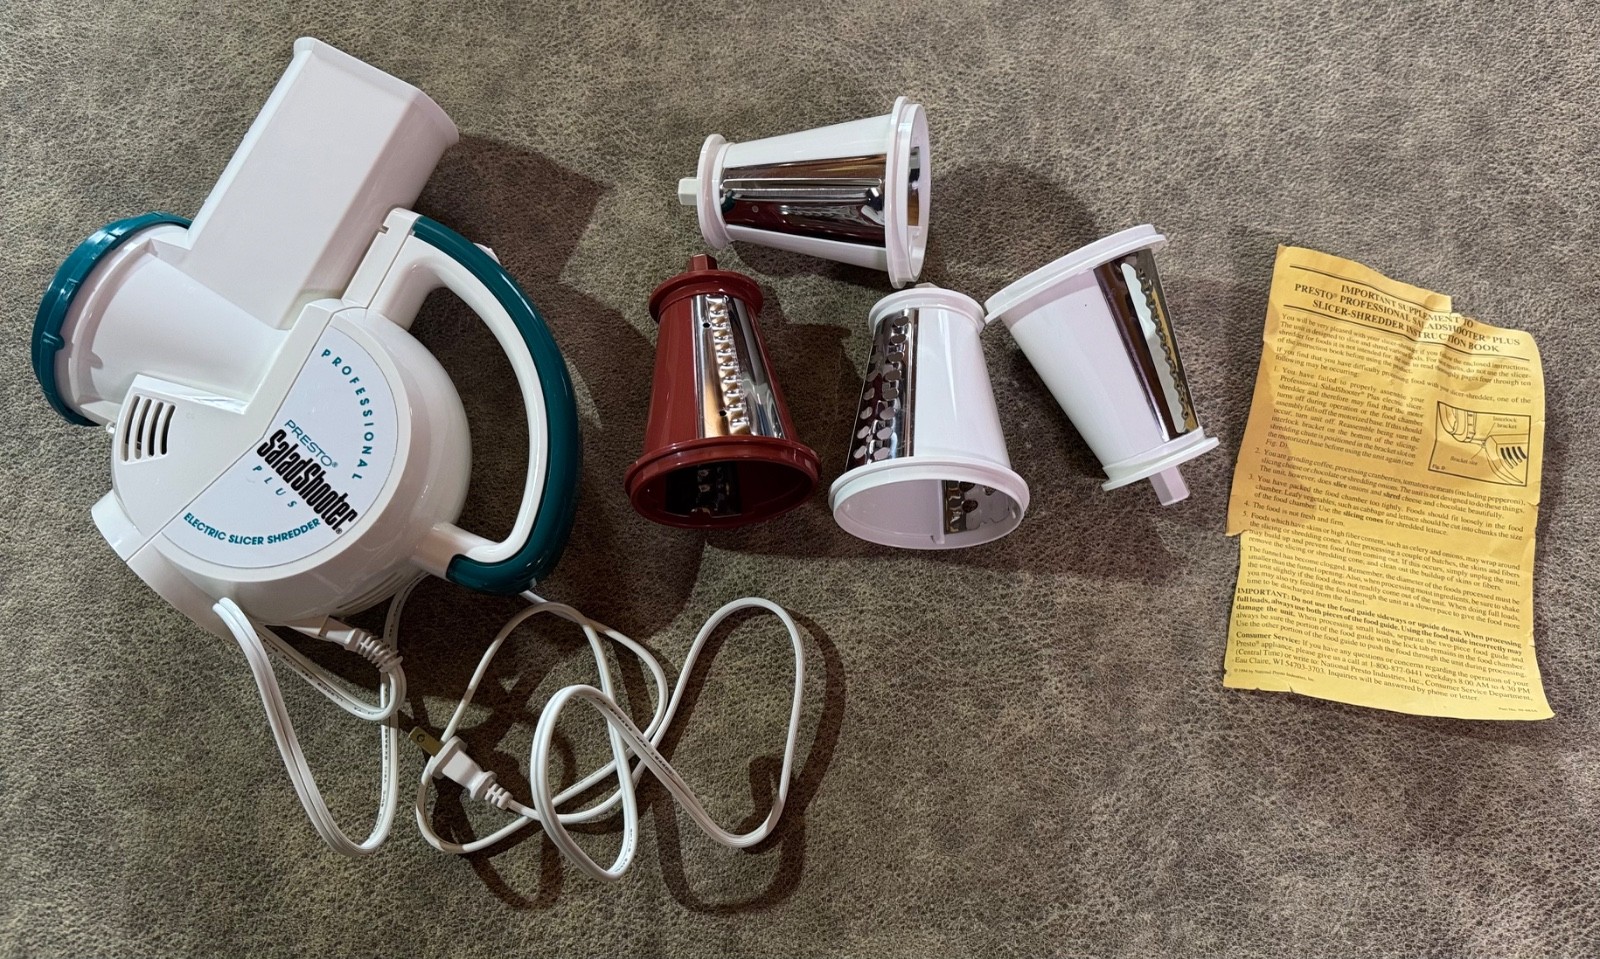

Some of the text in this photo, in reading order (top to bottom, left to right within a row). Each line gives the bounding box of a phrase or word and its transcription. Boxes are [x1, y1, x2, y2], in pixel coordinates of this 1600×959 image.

[1312, 300, 1500, 352] SLICER-SHREDDER INSTRUCTION BOOK
[1340, 296, 1411, 321] PROFESSIONAL
[1493, 336, 1521, 345] PLUS
[1341, 285, 1474, 328] IMPORTANT SUPPLEMENT TO
[1282, 367, 1296, 375] You
[1299, 371, 1314, 379] have
[1318, 374, 1337, 383] failed
[1349, 382, 1376, 393] properly
[321, 349, 374, 479] PROFESSIONAL
[1306, 397, 1327, 408] during
[1329, 403, 1358, 414] operation
[1382, 412, 1396, 420] food
[1398, 416, 1423, 426] chamber
[253, 465, 297, 508] PLUS
[1257, 475, 1271, 484] You
[1272, 479, 1287, 487] have
[1289, 482, 1311, 493] packed
[1325, 490, 1339, 498] food
[1341, 494, 1368, 504] chamber
[1406, 507, 1425, 515] Foods
[1427, 511, 1449, 520] should
[1460, 516, 1484, 527] loosely
[1494, 522, 1505, 530] the
[1508, 524, 1524, 533] food
[1260, 465, 1271, 473] The
[1288, 471, 1316, 483] however,
[1317, 477, 1332, 485] does
[1383, 491, 1401, 500] shred
[1401, 495, 1422, 504] cheese
[1423, 499, 1435, 507] and
[1436, 502, 1467, 513] chocolate
[183, 512, 320, 545] ELECTRIC SLICER SHREDDER
[1253, 502, 1265, 510] The
[1266, 505, 1281, 513] food
[1300, 512, 1316, 521] fresh
[1273, 495, 1288, 503] food
[1318, 505, 1331, 513] Use
[1343, 511, 1364, 521] slicing
[1365, 516, 1383, 524] cones
[1396, 521, 1424, 532] shredded
[1236, 603, 1264, 612] damage
[1266, 605, 1277, 613] the
[1280, 609, 1296, 617] unit.
[1297, 612, 1317, 622] When
[1319, 618, 1354, 630] processing
[1355, 624, 1374, 633] small
[1396, 633, 1424, 644] separate
[1473, 648, 1488, 656] food
[1490, 652, 1509, 661] guide
[1237, 587, 1290, 600] IMPORTANT:
[1339, 605, 1355, 613] food
[1356, 608, 1375, 618] guide
[1376, 612, 1407, 625] sideways
[1417, 621, 1439, 631] upside
[1441, 626, 1462, 635] down.
[1463, 630, 1484, 640] When
[1485, 635, 1522, 649] processing
[1236, 631, 1272, 639] Consumer
[1272, 633, 1301, 644] Service:
[1308, 642, 1321, 650] you
[1322, 645, 1338, 653] have
[1352, 650, 1384, 663] questions
[1394, 659, 1424, 669] concerns
[1425, 664, 1457, 676] regarding
[1457, 670, 1469, 678] the
[1470, 673, 1502, 683] operation
[1512, 680, 1529, 688] your
[1272, 658, 1284, 666] WI
[1328, 669, 1358, 681] Inquiries
[1359, 675, 1372, 683] will
[1384, 680, 1415, 691] answered
[1416, 686, 1425, 694] by
[1427, 687, 1448, 698] phone
[1296, 647, 1316, 656] please
[1317, 651, 1332, 661] give
[1424, 672, 1458, 684] weekdays
[1476, 681, 1490, 689] AM
[1518, 686, 1531, 694] PM
